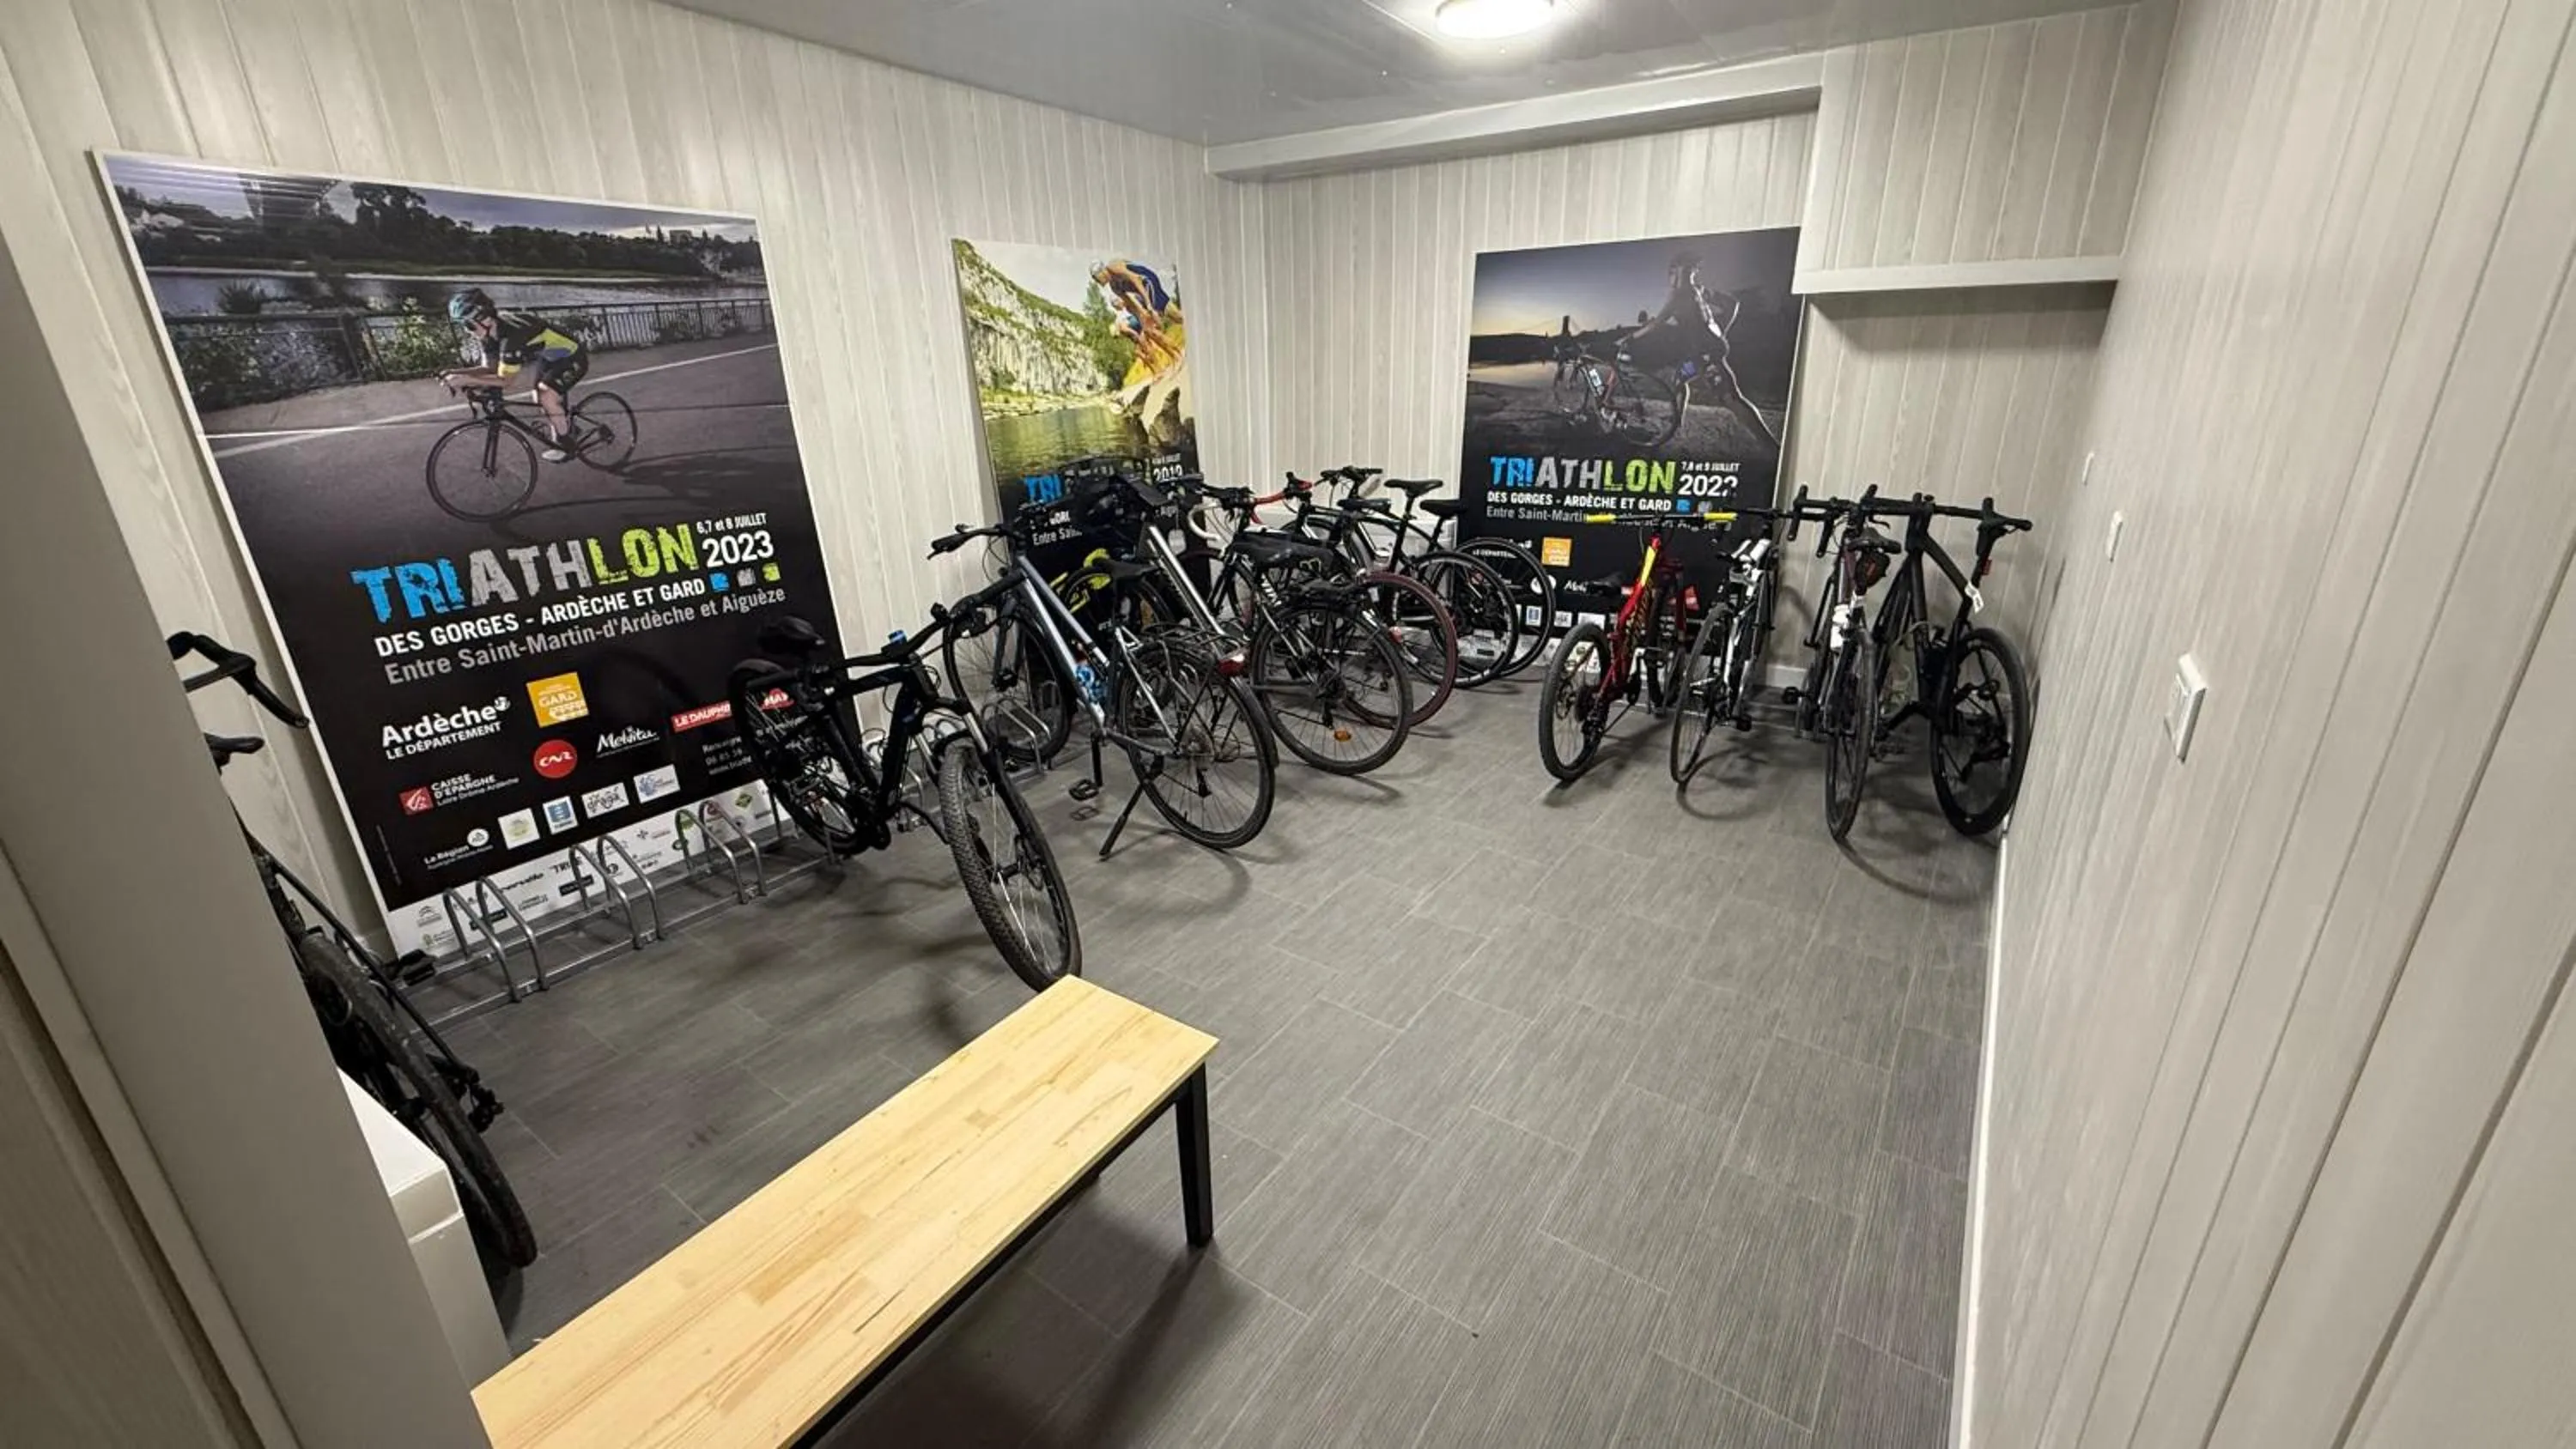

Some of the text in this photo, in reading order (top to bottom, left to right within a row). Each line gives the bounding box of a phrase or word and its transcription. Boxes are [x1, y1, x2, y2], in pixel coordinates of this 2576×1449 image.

[1490, 456, 1677, 494] TRIATHLON
[1678, 474, 1739, 497] 2022
[734, 512, 767, 529] JUILLET
[1486, 506, 1515, 520] Entre
[1487, 491, 1508, 504] DES
[1510, 492, 1553, 506] GORGES
[1564, 493, 1618, 510] ARDÈCHE
[1620, 497, 1636, 510] ET
[1637, 498, 1672, 512] GARD
[702, 530, 775, 568] 2023
[1033, 530, 1057, 546] Entre
[350, 523, 700, 625] TRIATHLON
[374, 633, 426, 658] DES
[430, 614, 519, 652] GORGES
[540, 590, 630, 626] ARDÈCHE
[635, 586, 656, 607] ET
[659, 578, 706, 603] GARD
[384, 585, 787, 686] Entre Saint-Martin-d'Ardèche et Aiguèze
[382, 705, 499, 748] Ardèche
[386, 721, 502, 761] LE DÉPARTEMENT
[430, 773, 471, 791] CAISSE
